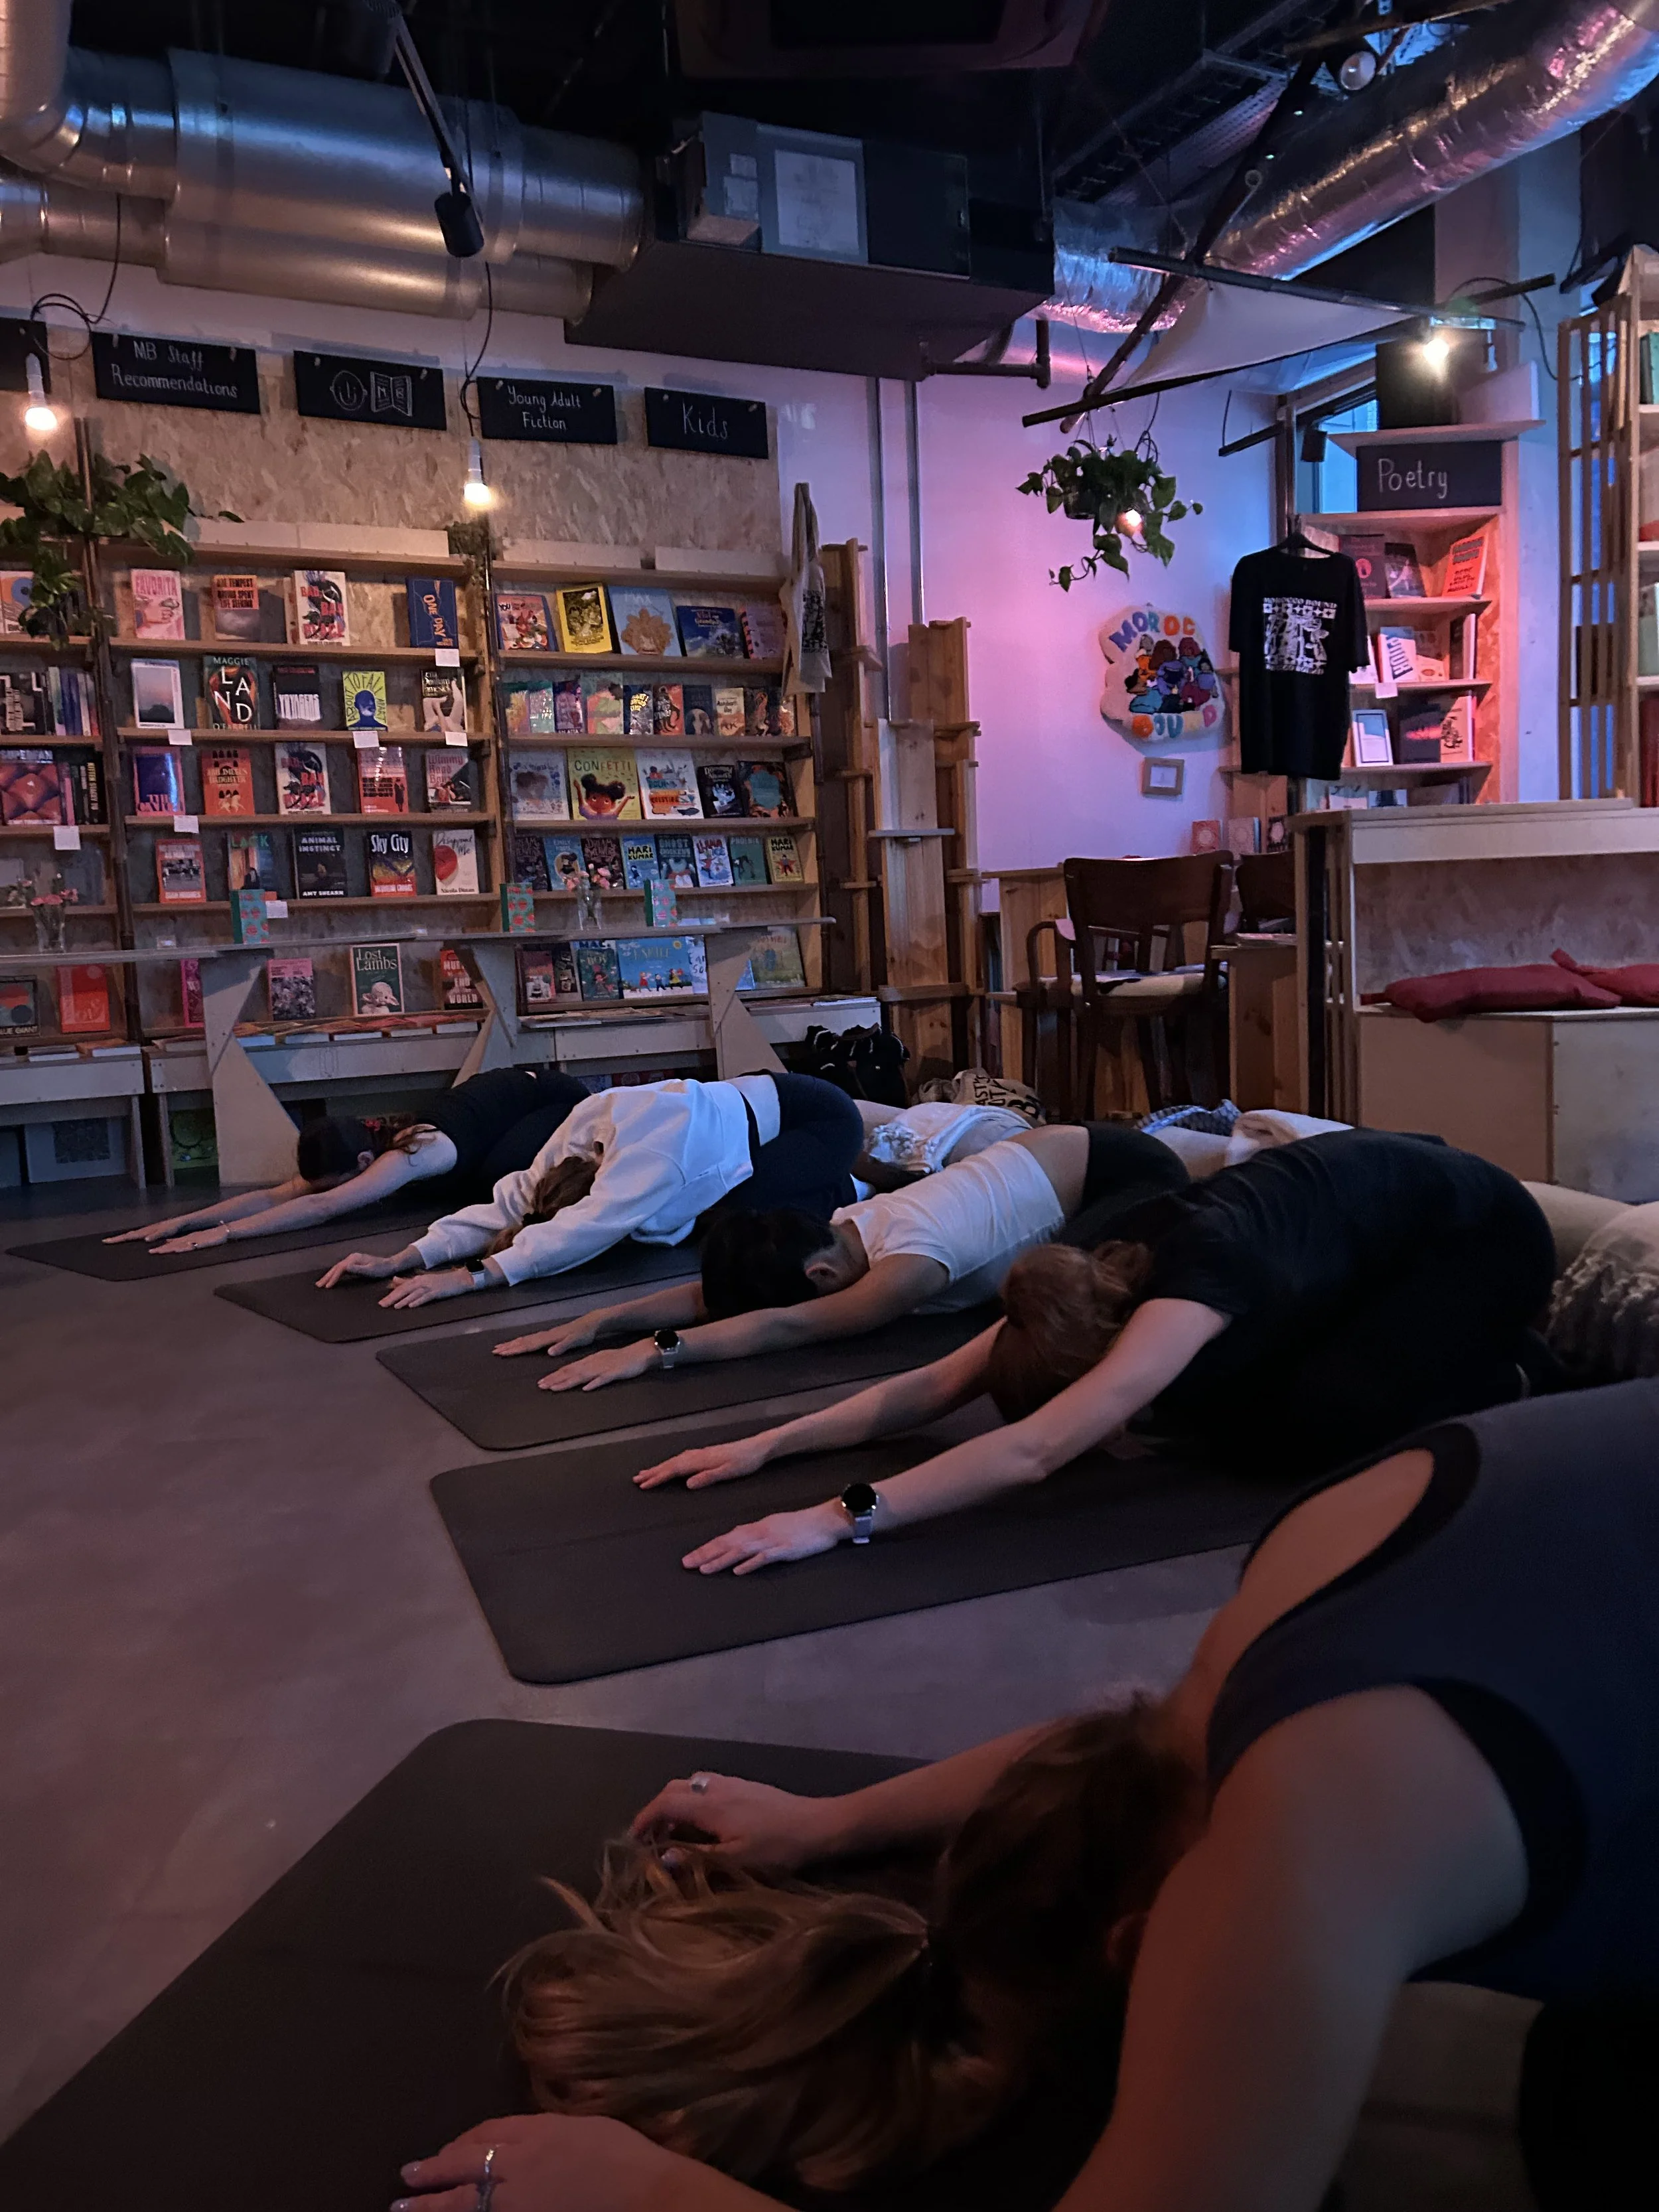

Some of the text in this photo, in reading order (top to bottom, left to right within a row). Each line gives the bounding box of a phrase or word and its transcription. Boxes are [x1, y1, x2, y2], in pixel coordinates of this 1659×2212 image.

[133, 340, 204, 372] MB Staff
[110, 362, 239, 399] Recommendations
[507, 384, 582, 413] Young Adult
[522, 411, 568, 431] Fiction
[682, 398, 729, 440] Kids
[1378, 457, 1449, 500] Poetry
[423, 593, 438, 615] ONE
[212, 656, 250, 666] MAGGIE
[344, 672, 361, 692] TO
[345, 688, 359, 722] ABOUT
[428, 755, 464, 765] Wimmy
[573, 759, 631, 772] CONFETTI
[370, 834, 409, 854] Sky City
[458, 845, 470, 855] Me
[628, 845, 652, 854] HARI
[356, 956, 398, 972] Lambs
[358, 948, 382, 961] Lost
